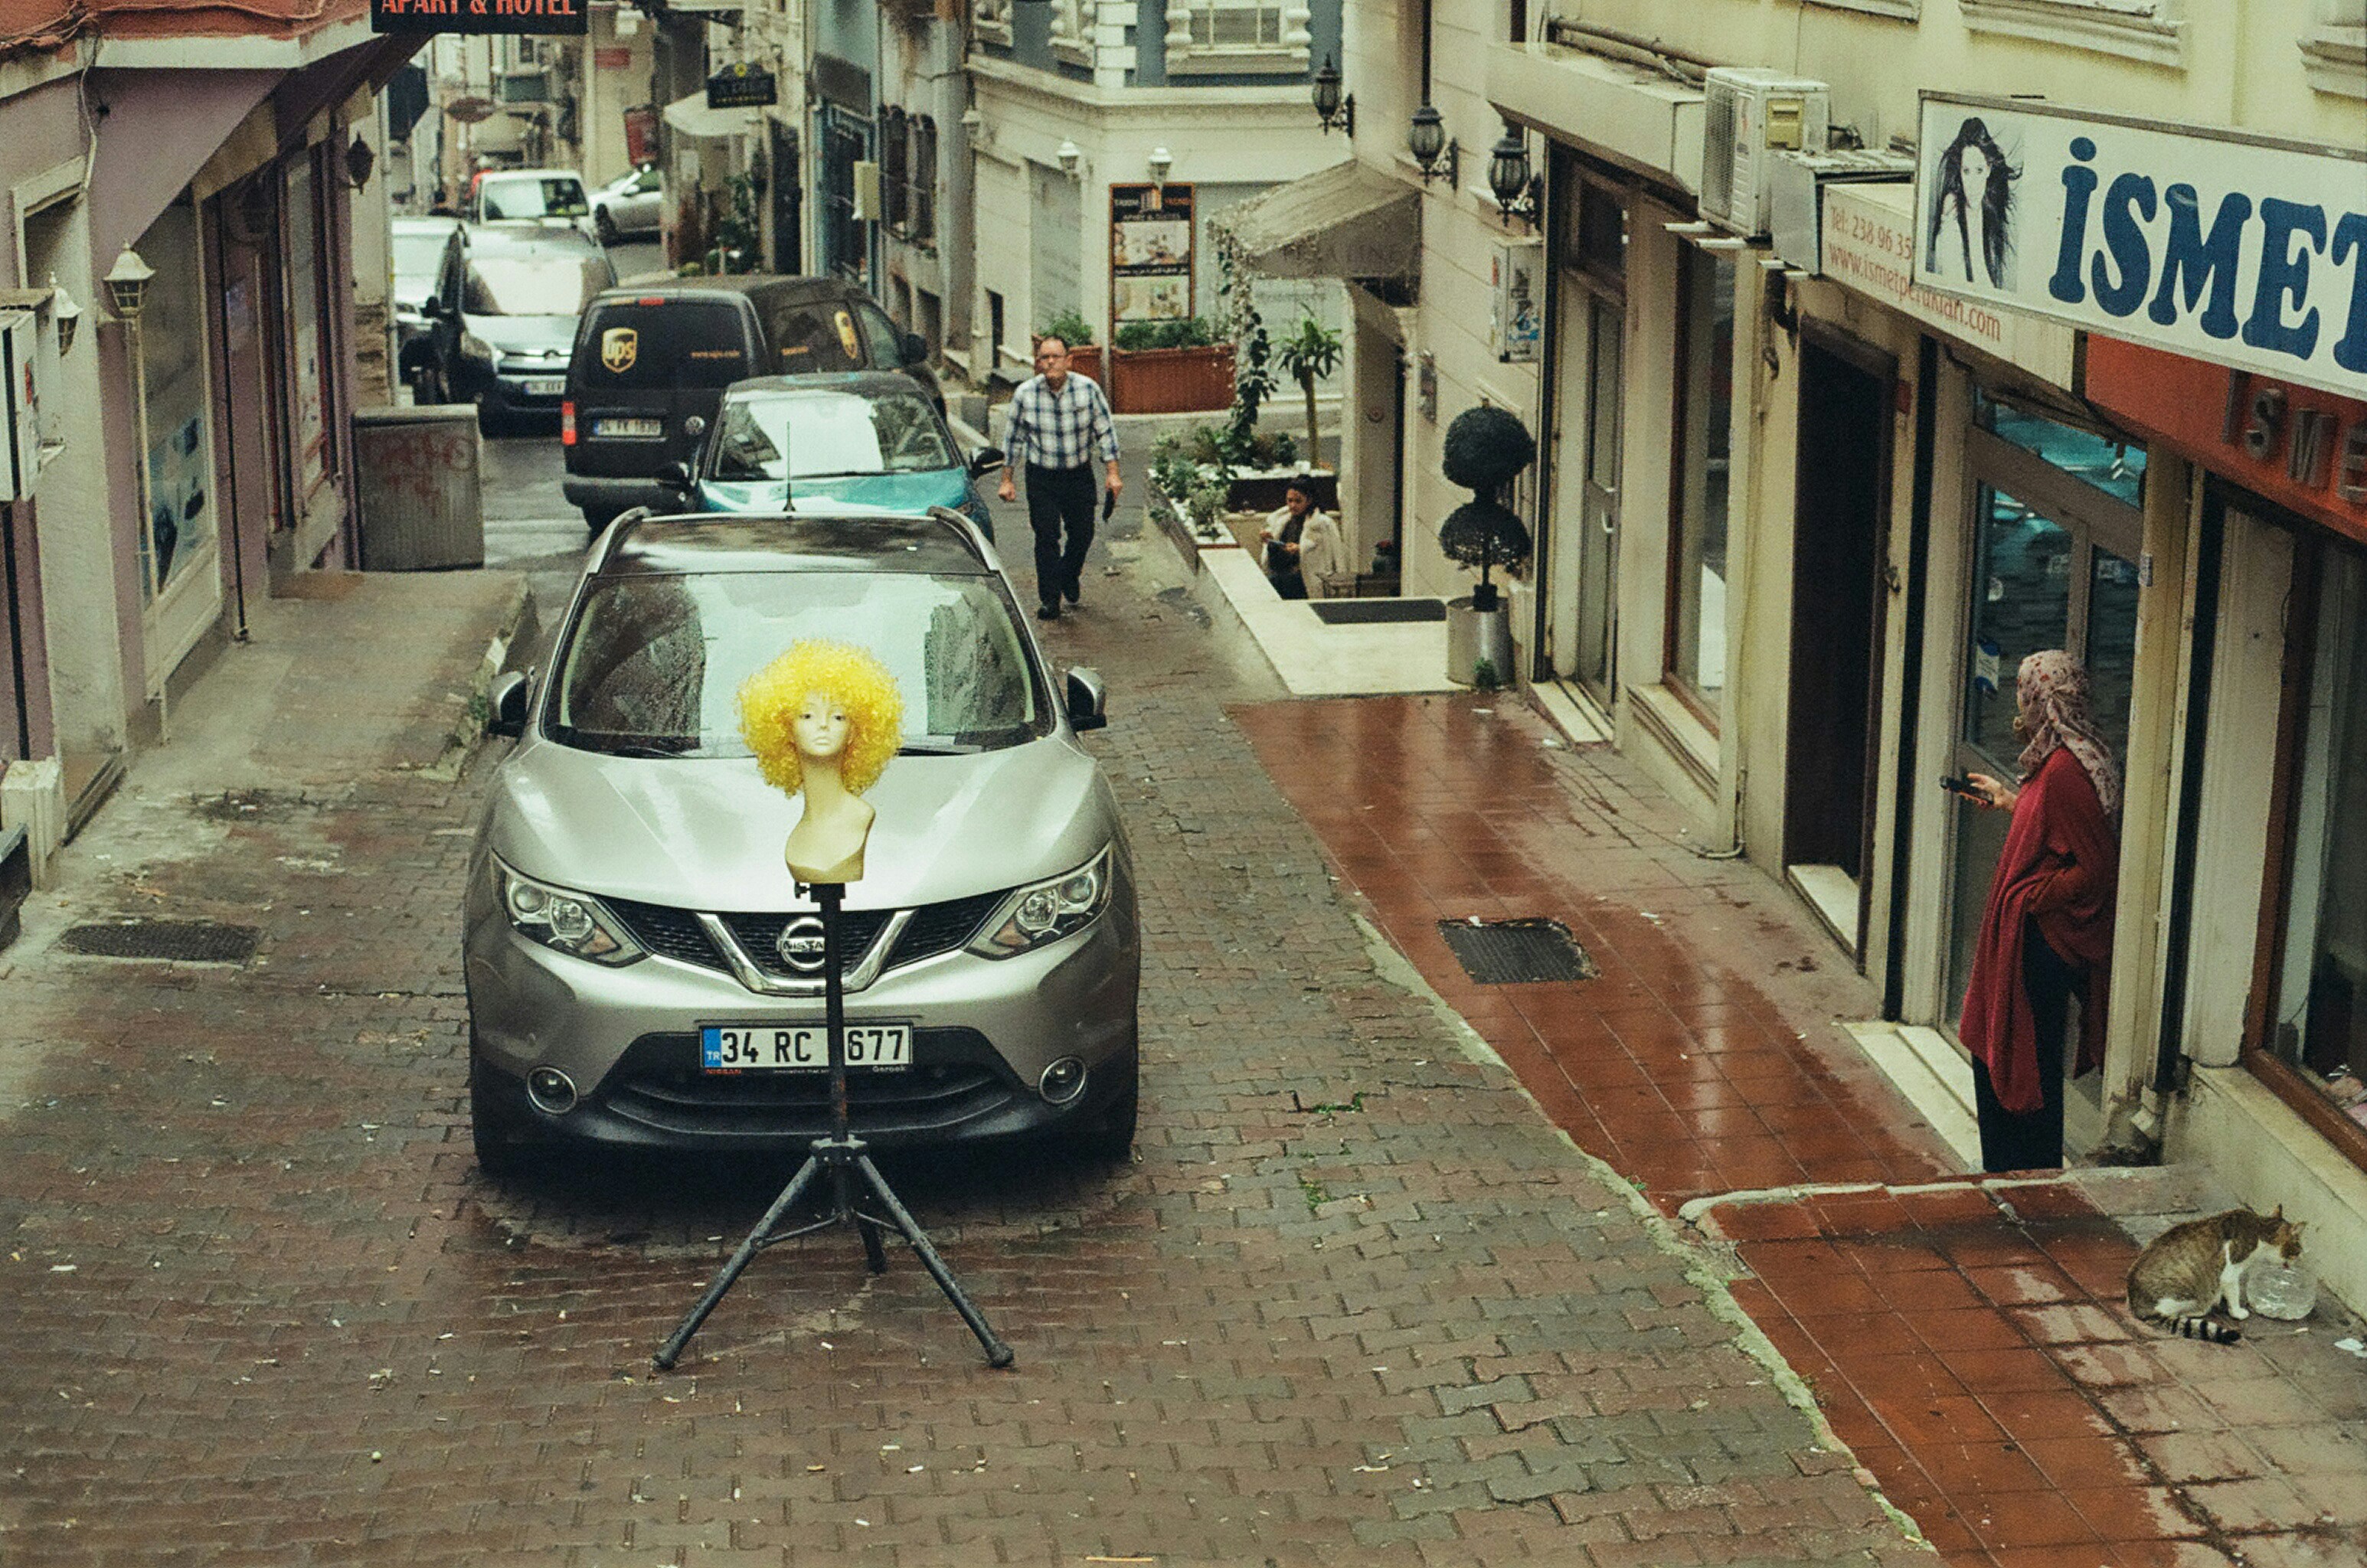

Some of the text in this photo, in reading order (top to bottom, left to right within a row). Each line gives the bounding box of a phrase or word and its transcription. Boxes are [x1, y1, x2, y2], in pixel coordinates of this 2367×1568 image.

[381, 0, 577, 15] APART & HOTEL
[1830, 206, 1912, 260] Tel: 238 96 35
[605, 341, 636, 367] ups
[783, 939, 826, 950] NISSA
[706, 1050, 721, 1061] TR
[722, 1031, 759, 1063] 34
[774, 1031, 812, 1063] RC
